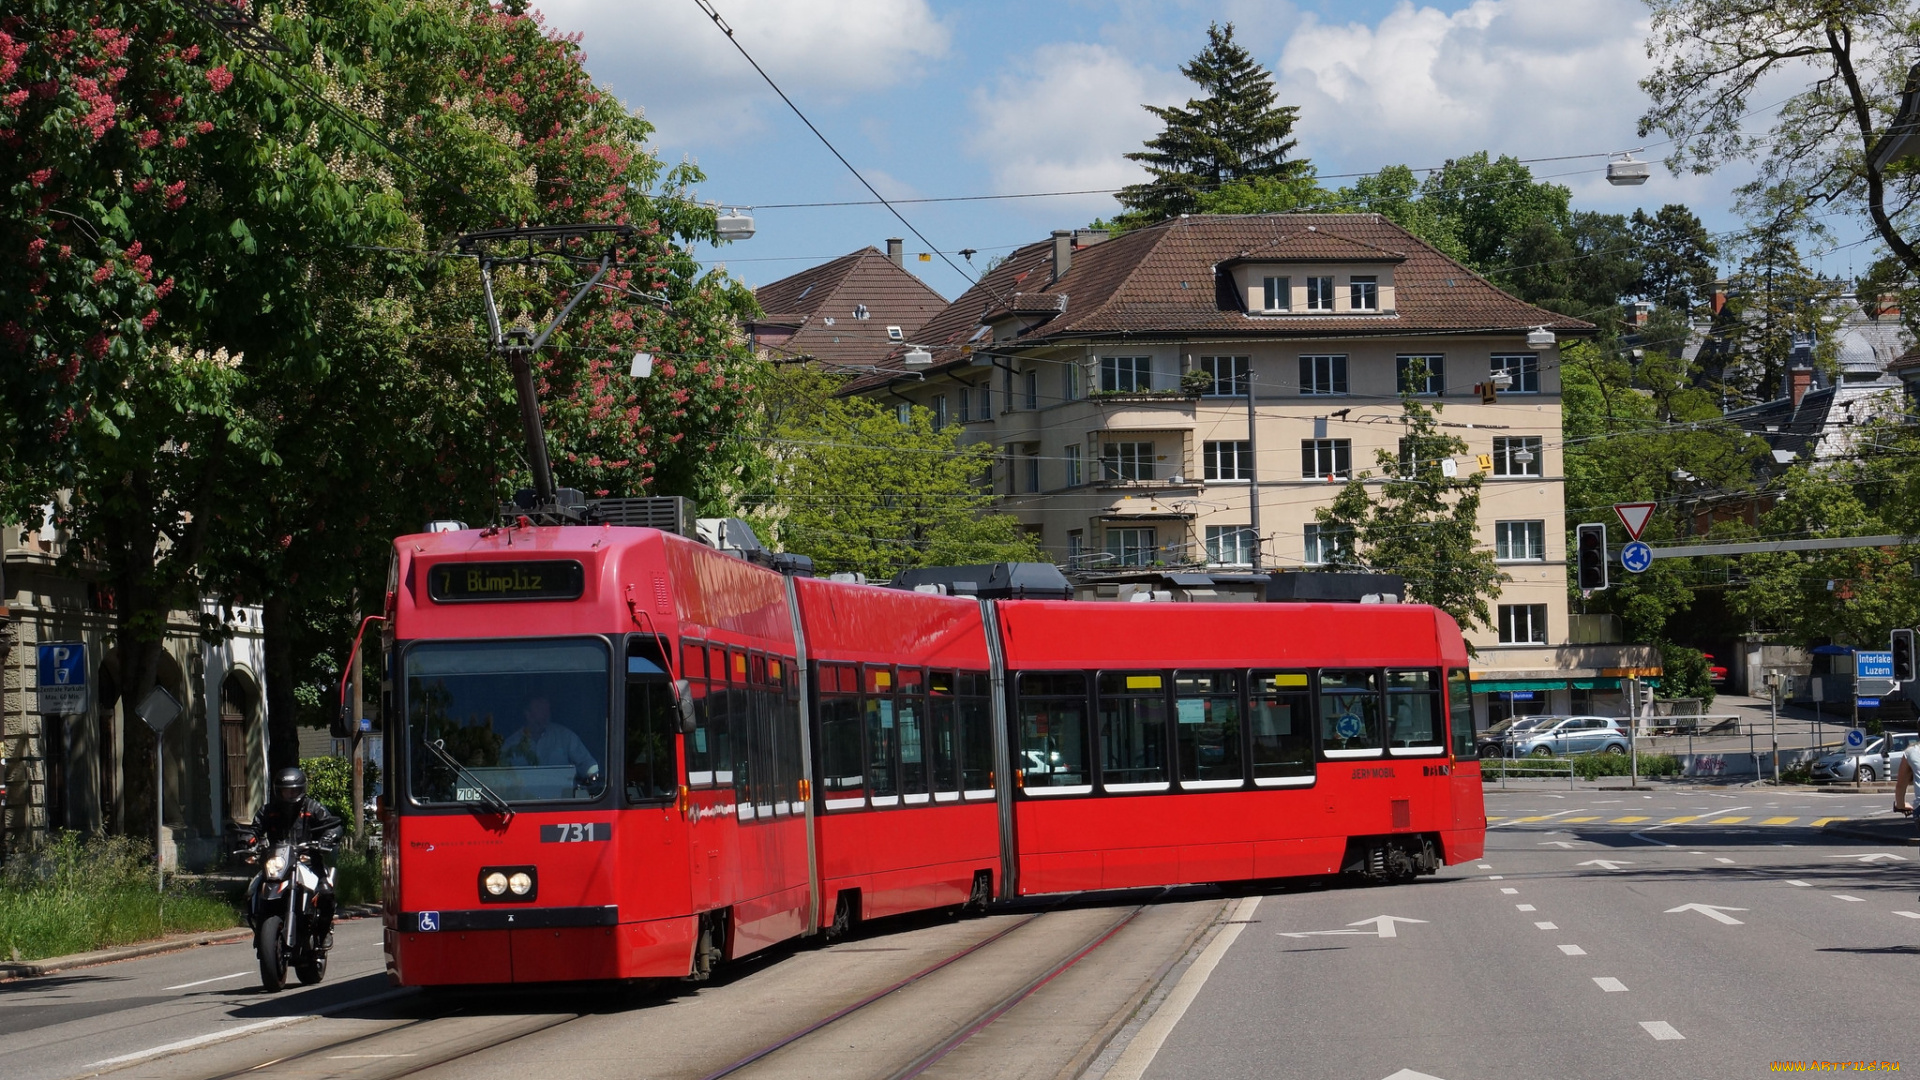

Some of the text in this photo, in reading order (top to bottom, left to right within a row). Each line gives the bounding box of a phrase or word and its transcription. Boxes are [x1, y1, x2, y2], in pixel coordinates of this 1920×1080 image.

[440, 569, 542, 593] 7 Bümpliz
[53, 647, 70, 668] P
[1865, 666, 1890, 675] Luzern
[557, 822, 595, 843] 731
